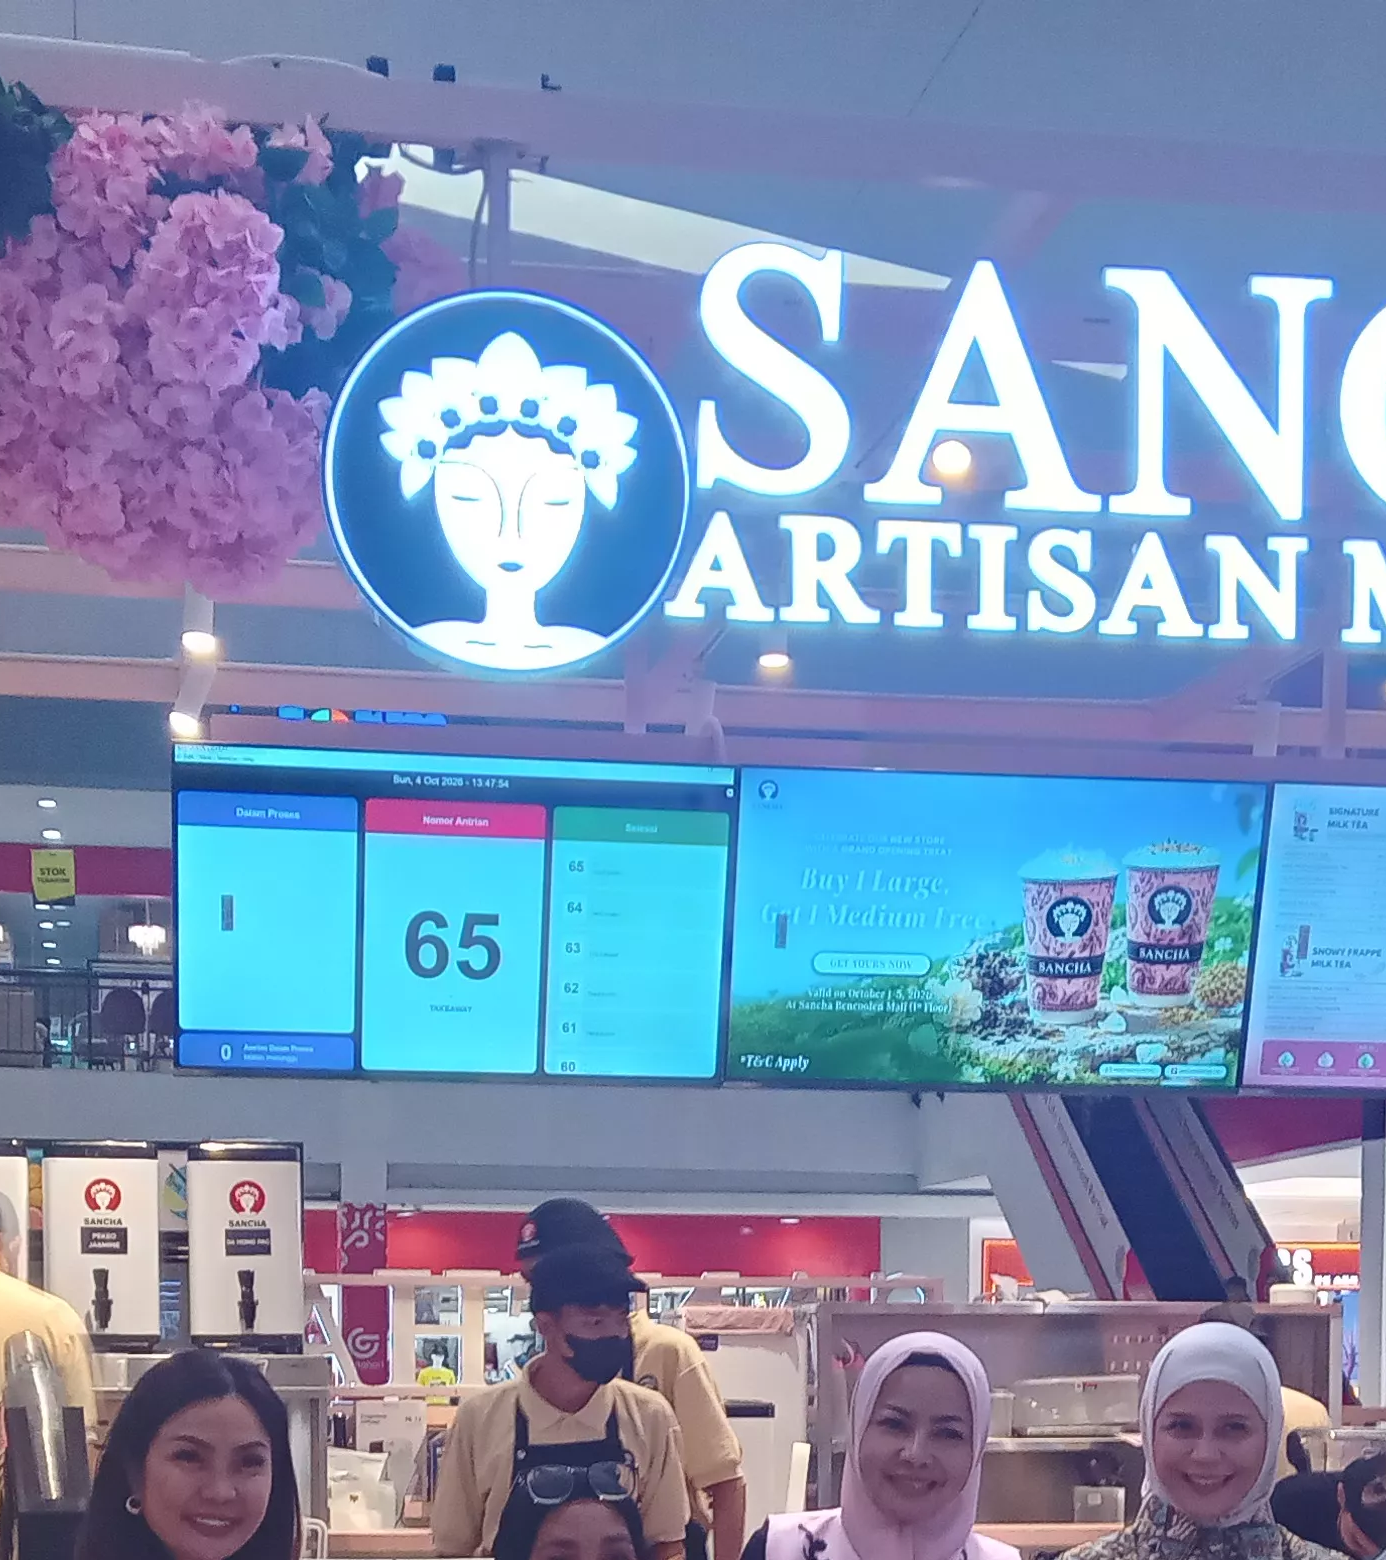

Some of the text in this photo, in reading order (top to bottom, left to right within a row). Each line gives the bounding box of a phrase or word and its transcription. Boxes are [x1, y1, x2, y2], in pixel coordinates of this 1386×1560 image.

[665, 512, 1312, 645] ARTISAN
[423, 776, 440, 786] Oct
[1329, 807, 1381, 817] SIGNATURE
[422, 815, 489, 827] Nomor Antrian
[1327, 819, 1369, 830] MILK TEA
[914, 836, 946, 846] STORE
[39, 867, 66, 876] STOK
[568, 860, 585, 873] 65
[801, 867, 849, 898] Buy
[872, 869, 951, 900] Large,
[566, 901, 583, 914] 64
[826, 904, 926, 929] Medium
[404, 910, 502, 981] 65
[565, 941, 582, 954] 63
[1311, 947, 1383, 958] SNOWY FRAPPE
[1310, 959, 1352, 969] MILK TEA
[563, 982, 580, 994] 62
[833, 990, 846, 998] on
[847, 989, 886, 1000] October
[798, 1000, 833, 1011] Sancha
[561, 1022, 577, 1034] 61
[220, 1044, 233, 1062] 0
[560, 1061, 576, 1073] 60
[775, 1054, 811, 1072] Apply
[83, 1217, 124, 1226] SANCHA
[228, 1219, 267, 1228] SANCHA
